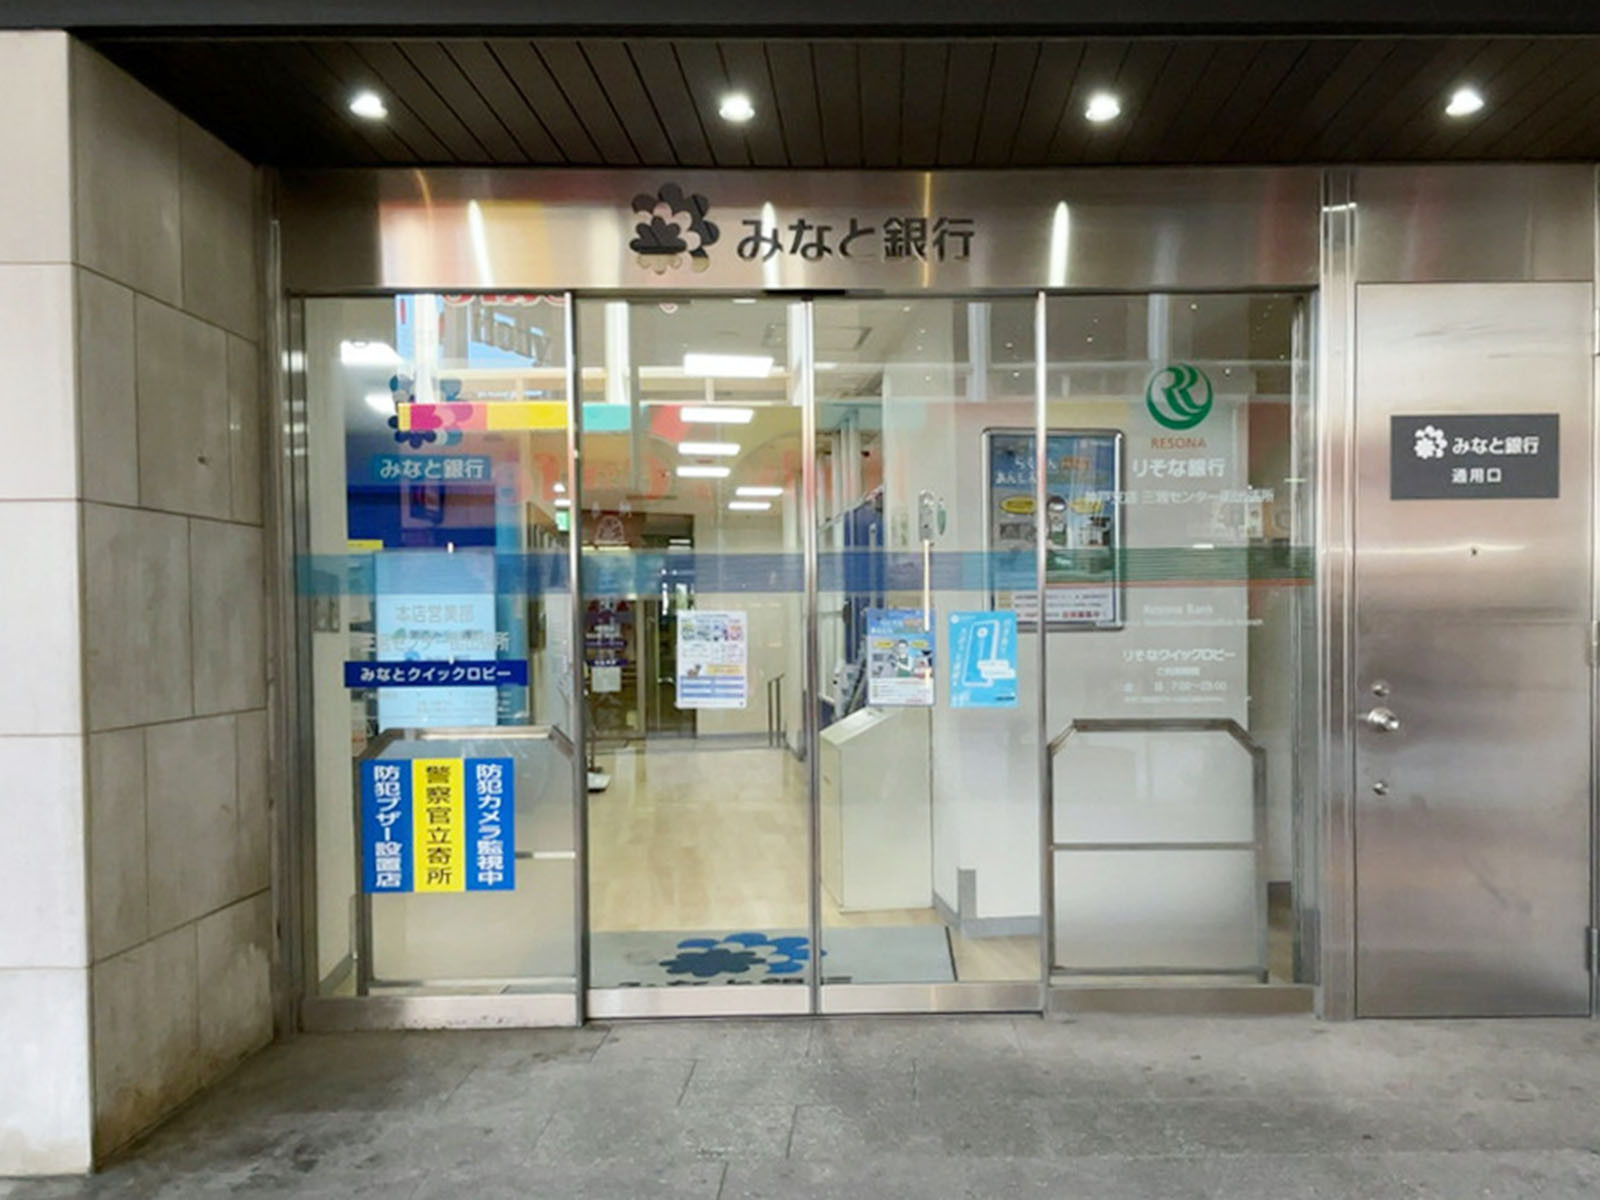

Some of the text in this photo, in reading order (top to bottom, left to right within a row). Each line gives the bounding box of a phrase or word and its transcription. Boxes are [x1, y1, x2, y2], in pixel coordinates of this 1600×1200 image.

[737, 217, 975, 263] みなと銀行
[1151, 437, 1207, 449] RESONA
[1452, 436, 1540, 455] みなと銀行
[379, 458, 485, 479] みなと銀行
[1132, 457, 1226, 478] りそな銀行
[1451, 467, 1502, 484] 通用口
[360, 666, 512, 682] みなとクイックロビー
[373, 765, 403, 888] 防犯ブザー設置店
[425, 765, 453, 885] 警察官立寄所
[475, 764, 504, 886] 防犯カメラ監視中
